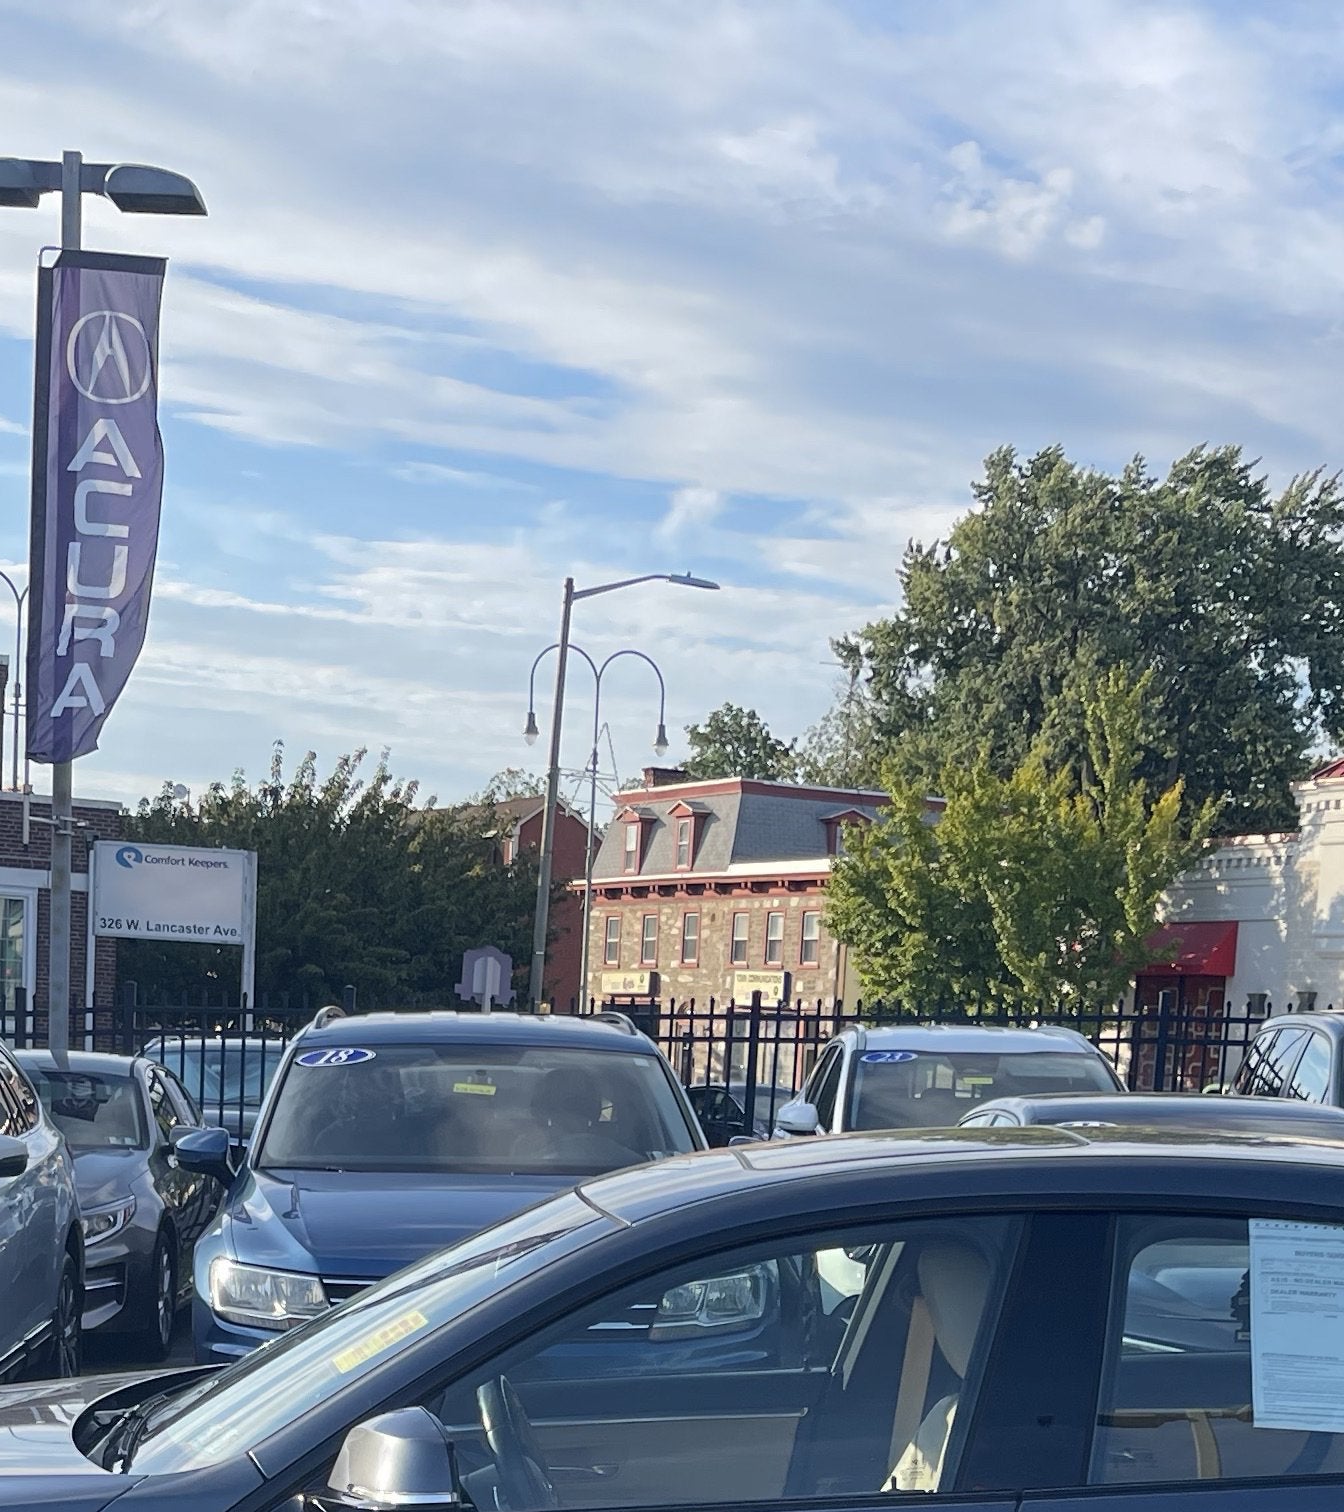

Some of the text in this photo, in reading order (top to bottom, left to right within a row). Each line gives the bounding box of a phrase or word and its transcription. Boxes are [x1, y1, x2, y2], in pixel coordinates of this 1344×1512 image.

[50, 418, 142, 717] ACURA
[144, 855, 185, 867] Comfort
[99, 917, 241, 937] 326 W. Lancaster Ave.
[316, 1048, 355, 1065] 18
